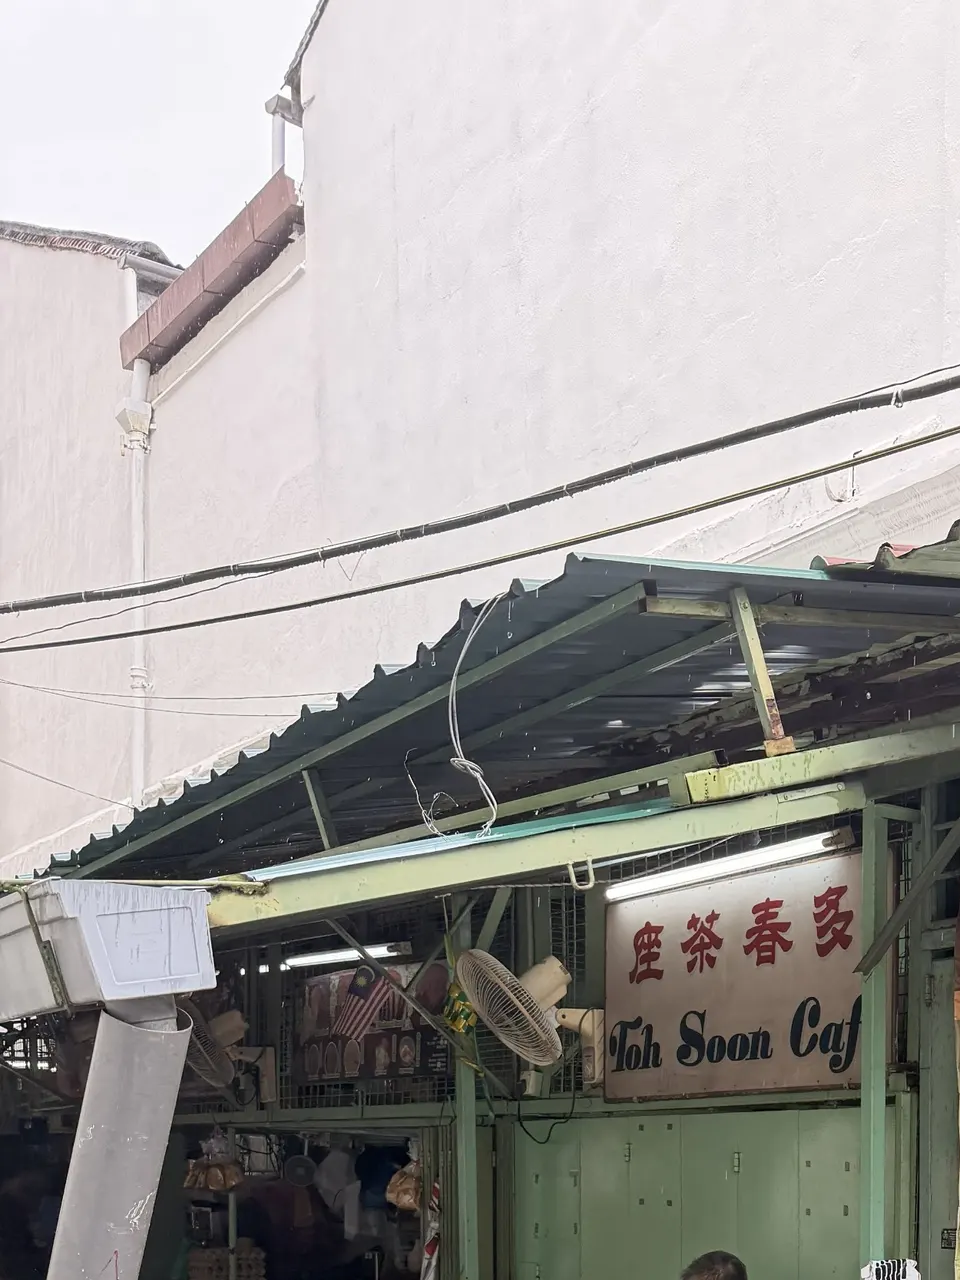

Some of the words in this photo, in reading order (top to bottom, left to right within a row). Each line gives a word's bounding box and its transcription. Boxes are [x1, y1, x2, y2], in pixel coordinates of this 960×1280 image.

[609, 1016, 662, 1073] Toh
[676, 1010, 773, 1067] Soon
[790, 995, 862, 1074] Caf
